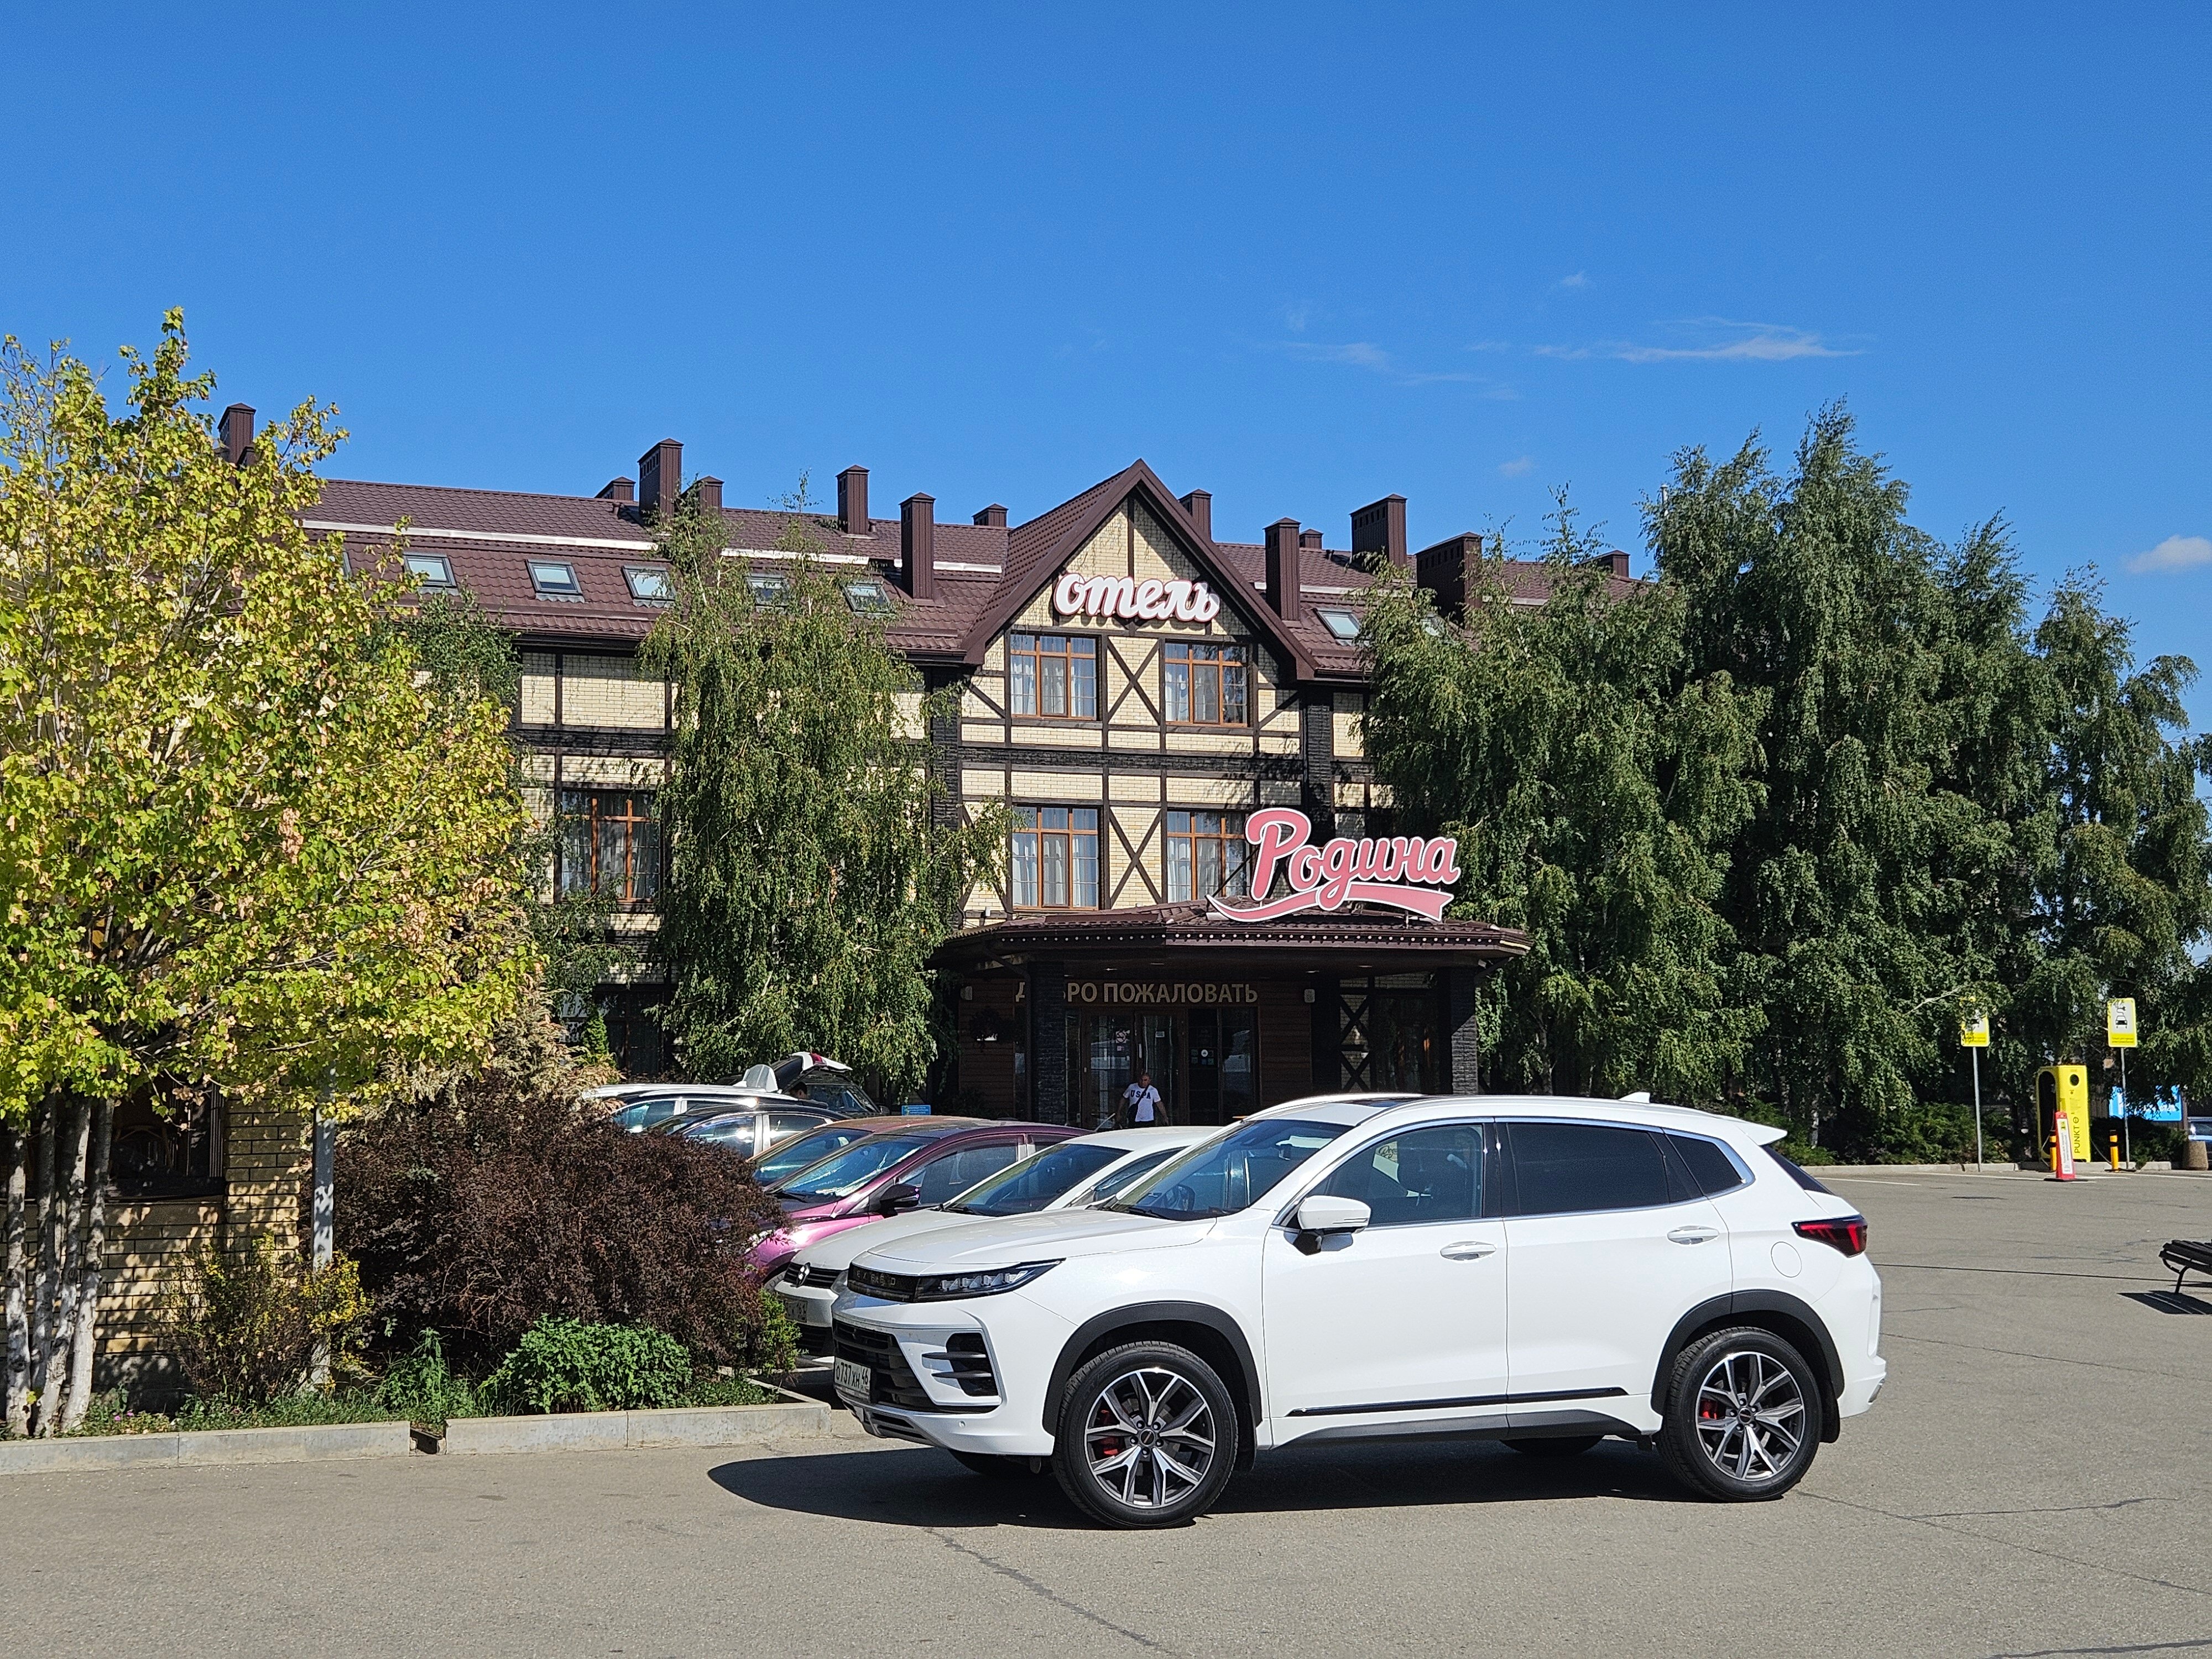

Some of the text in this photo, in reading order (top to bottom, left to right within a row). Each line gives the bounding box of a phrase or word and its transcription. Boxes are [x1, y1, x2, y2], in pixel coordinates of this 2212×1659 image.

[1053, 572, 1220, 622] отель
[1245, 807, 1461, 911] Родина
[1104, 982, 1258, 1004] ПОЖАЛОВАТЬ
